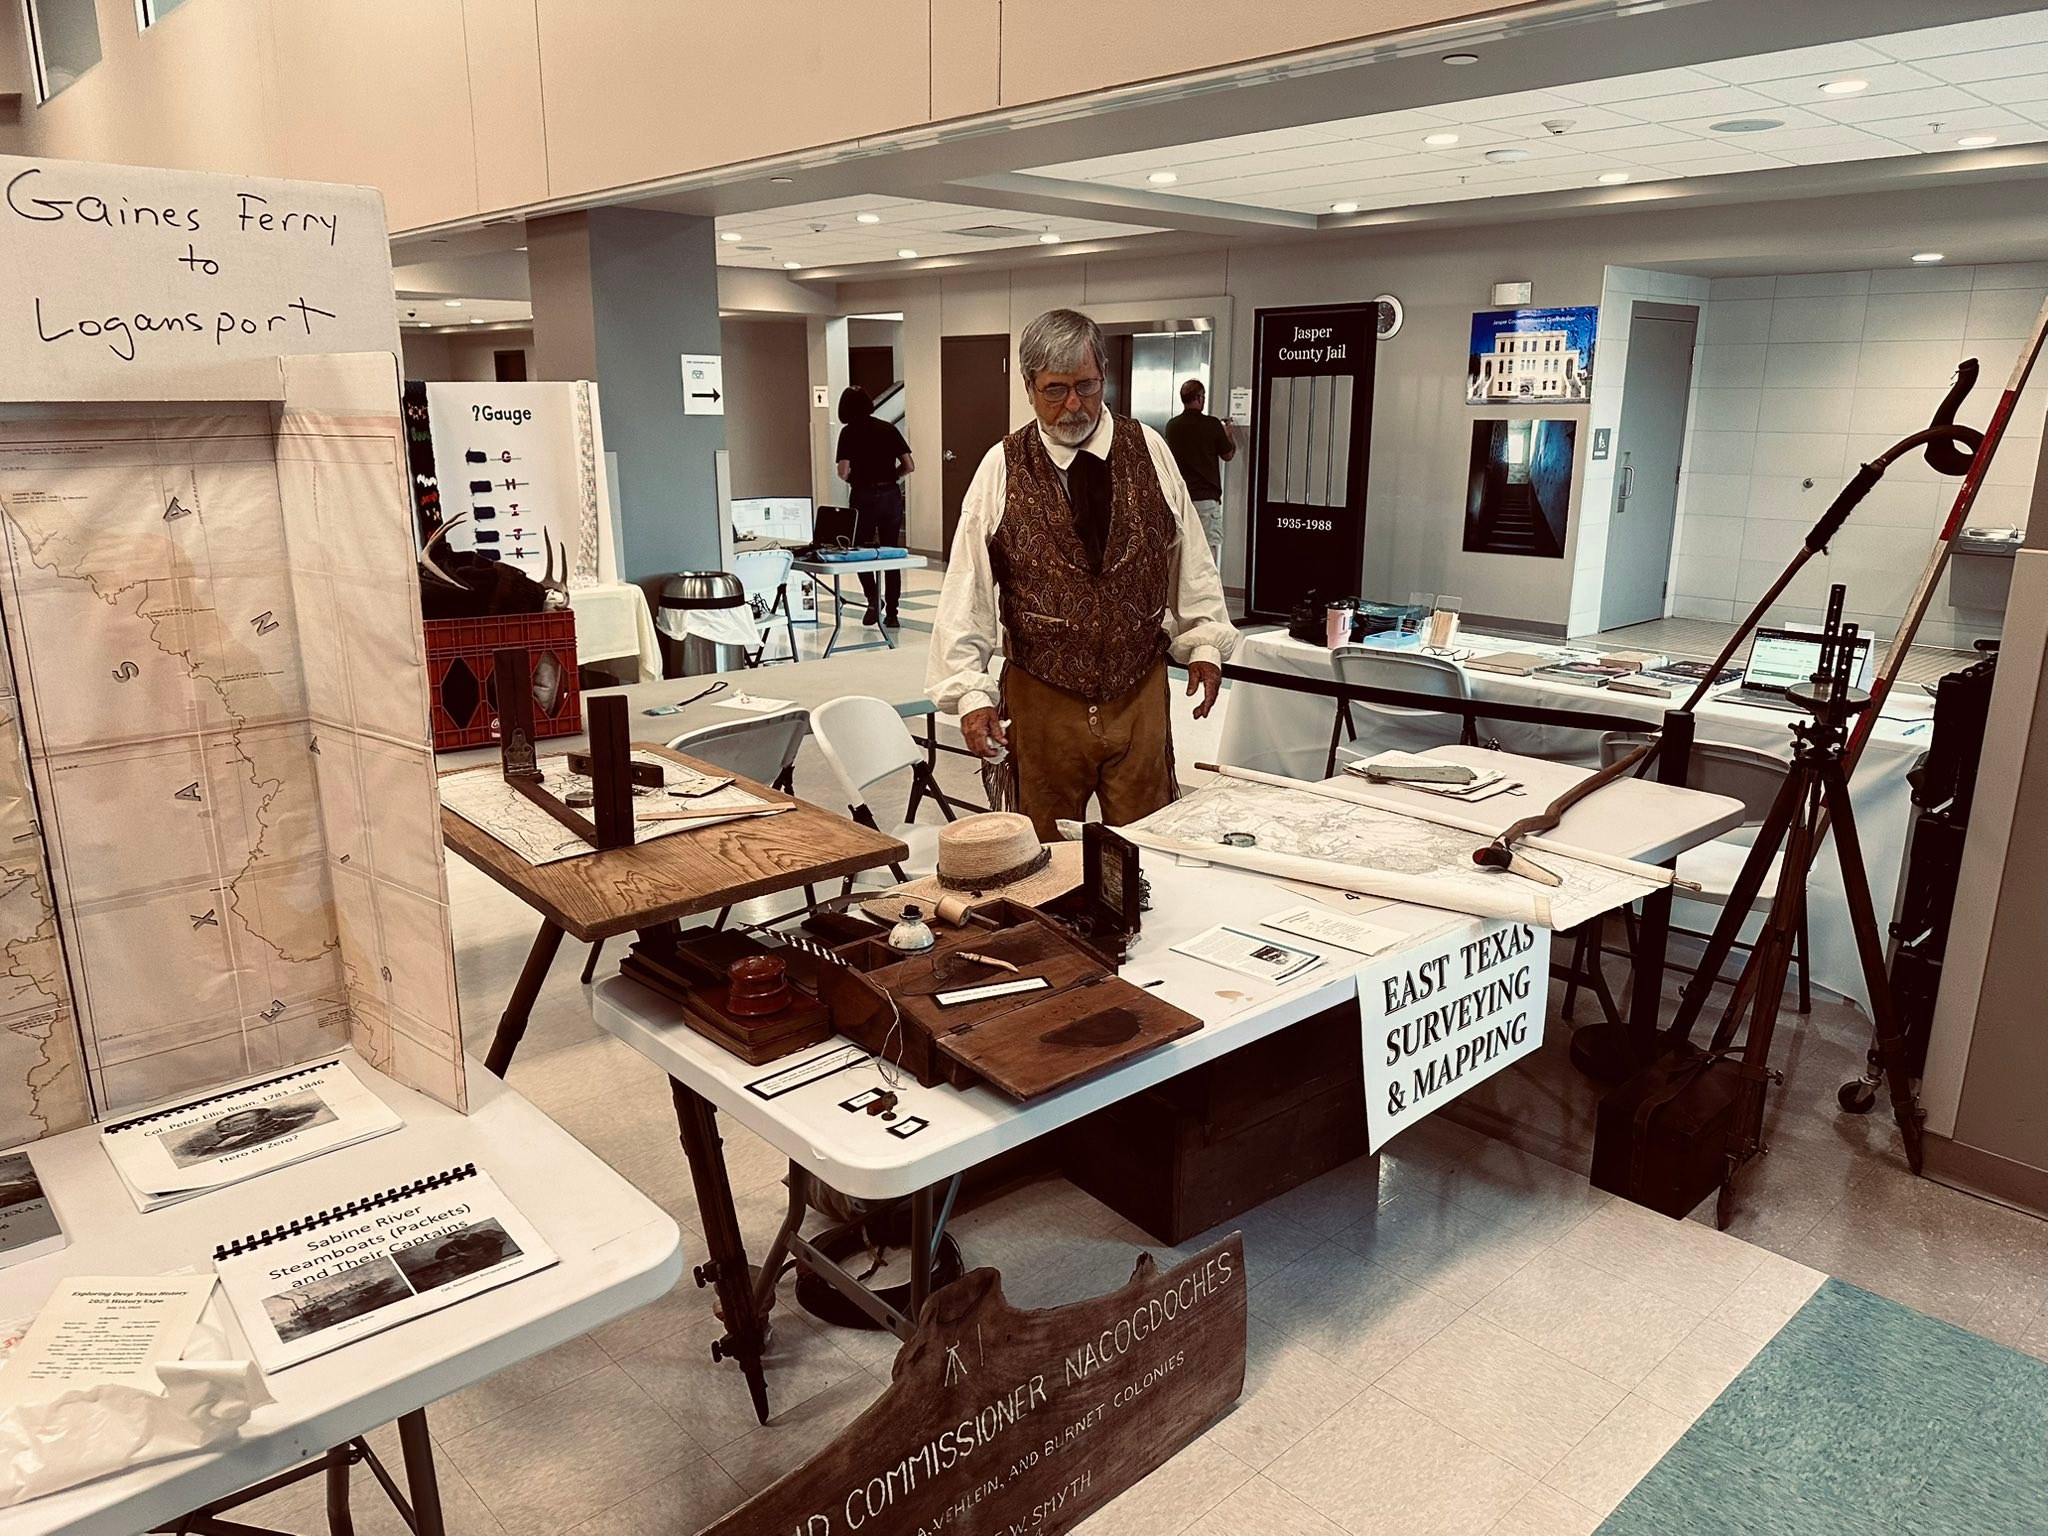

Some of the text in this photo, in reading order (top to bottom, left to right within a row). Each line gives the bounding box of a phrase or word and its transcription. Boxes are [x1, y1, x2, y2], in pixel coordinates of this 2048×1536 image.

[7, 168, 338, 246] Gaines Ferry
[178, 244, 219, 275] to
[35, 297, 336, 360] Logansport
[1279, 344, 1347, 363] County Jail
[1293, 325, 1333, 342] Jasper
[501, 450, 512, 463] G
[504, 478, 517, 491] H
[515, 547, 525, 559] K
[1276, 517, 1333, 531] 1935-1988
[1381, 923, 1535, 1016] EAST TEXAS
[1386, 965, 1531, 1067] SURVEYING
[1387, 1011, 1528, 1117] & MAPPING
[143, 1127, 166, 1138] Col.
[168, 1118, 200, 1131] Peter
[202, 1108, 226, 1121] Ellis
[261, 1089, 290, 1102] 1783
[297, 1079, 326, 1092] 1846
[218, 1135, 300, 1164] Hero or Zero?
[268, 1202, 472, 1281] Steamboats (Packets)
[290, 1220, 469, 1290] and Their Captains
[306, 1204, 422, 1252] Sabine River
[845, 1375, 1048, 1531] COMMISSIONER
[1064, 1251, 1233, 1388] NACOGDOCHES
[1008, 1450, 1040, 1482] AND
[1044, 1403, 1106, 1458] BURNET
[1113, 1351, 1186, 1409] COLONIES
[1031, 1469, 1093, 1526] SMYTH
